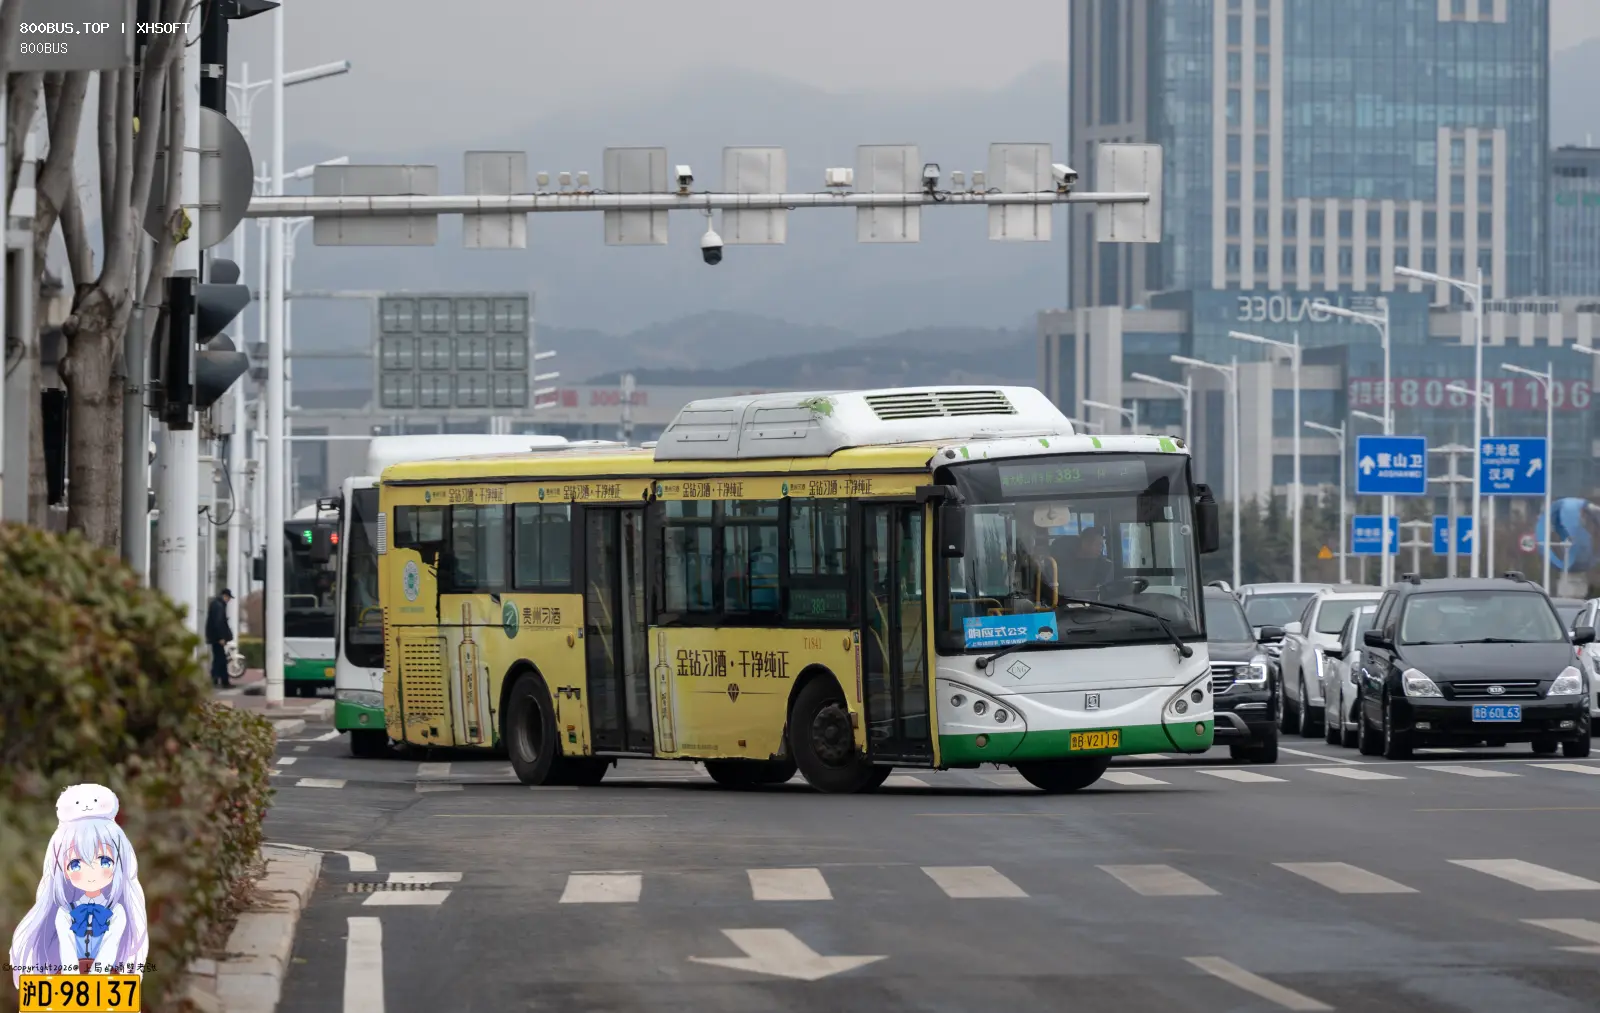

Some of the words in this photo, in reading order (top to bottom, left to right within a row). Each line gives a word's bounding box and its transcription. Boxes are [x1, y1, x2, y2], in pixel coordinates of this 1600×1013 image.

[1400, 379, 1591, 409] 8081106
[1057, 468, 1081, 482] 383
[811, 597, 826, 614] 383
[523, 607, 561, 625] 贵州习酒
[967, 626, 1028, 639] 响应式公交
[803, 637, 823, 650] T1841
[1011, 662, 1028, 674] CNG
